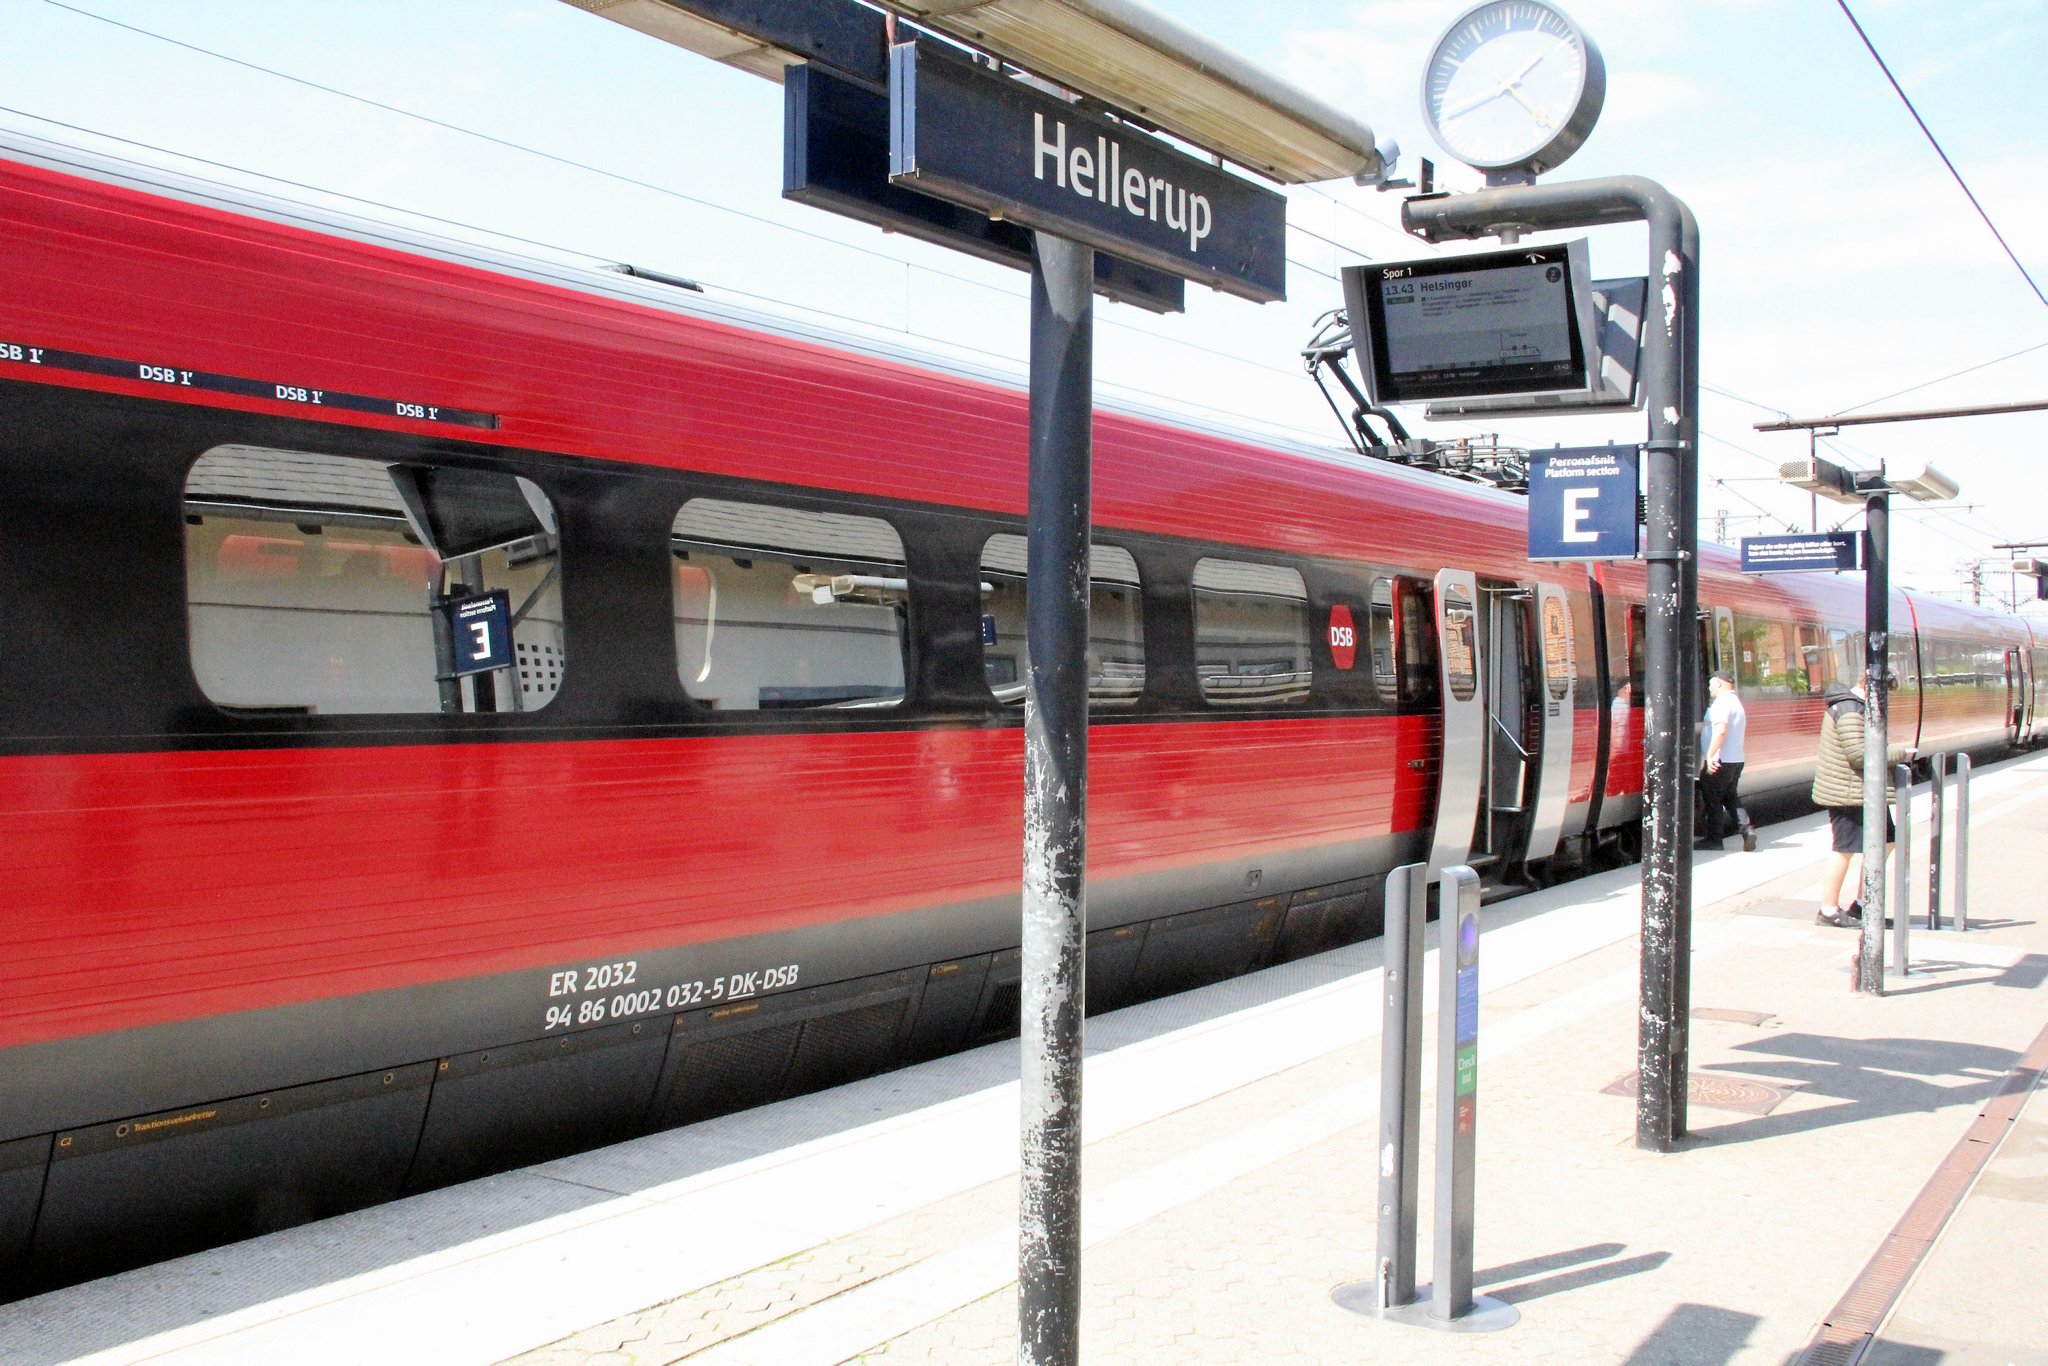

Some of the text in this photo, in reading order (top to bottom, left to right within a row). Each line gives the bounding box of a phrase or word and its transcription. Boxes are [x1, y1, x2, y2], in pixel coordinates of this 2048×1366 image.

[1034, 111, 1212, 252] Hellerup
[1382, 266, 1412, 280] Spor 1
[1385, 283, 1414, 296] 13.43
[0, 343, 23, 361] SB
[139, 364, 176, 384] DSB
[275, 385, 308, 403] DSB
[396, 402, 425, 419] DSB
[1549, 455, 1616, 467] Perronafsnit
[1544, 466, 1620, 478] Platform section
[1563, 487, 1600, 543] E
[1331, 626, 1353, 646] DSB
[549, 961, 637, 997] ER 2032
[545, 964, 799, 1030] 94 86 0002 032-5 DK-DSB
